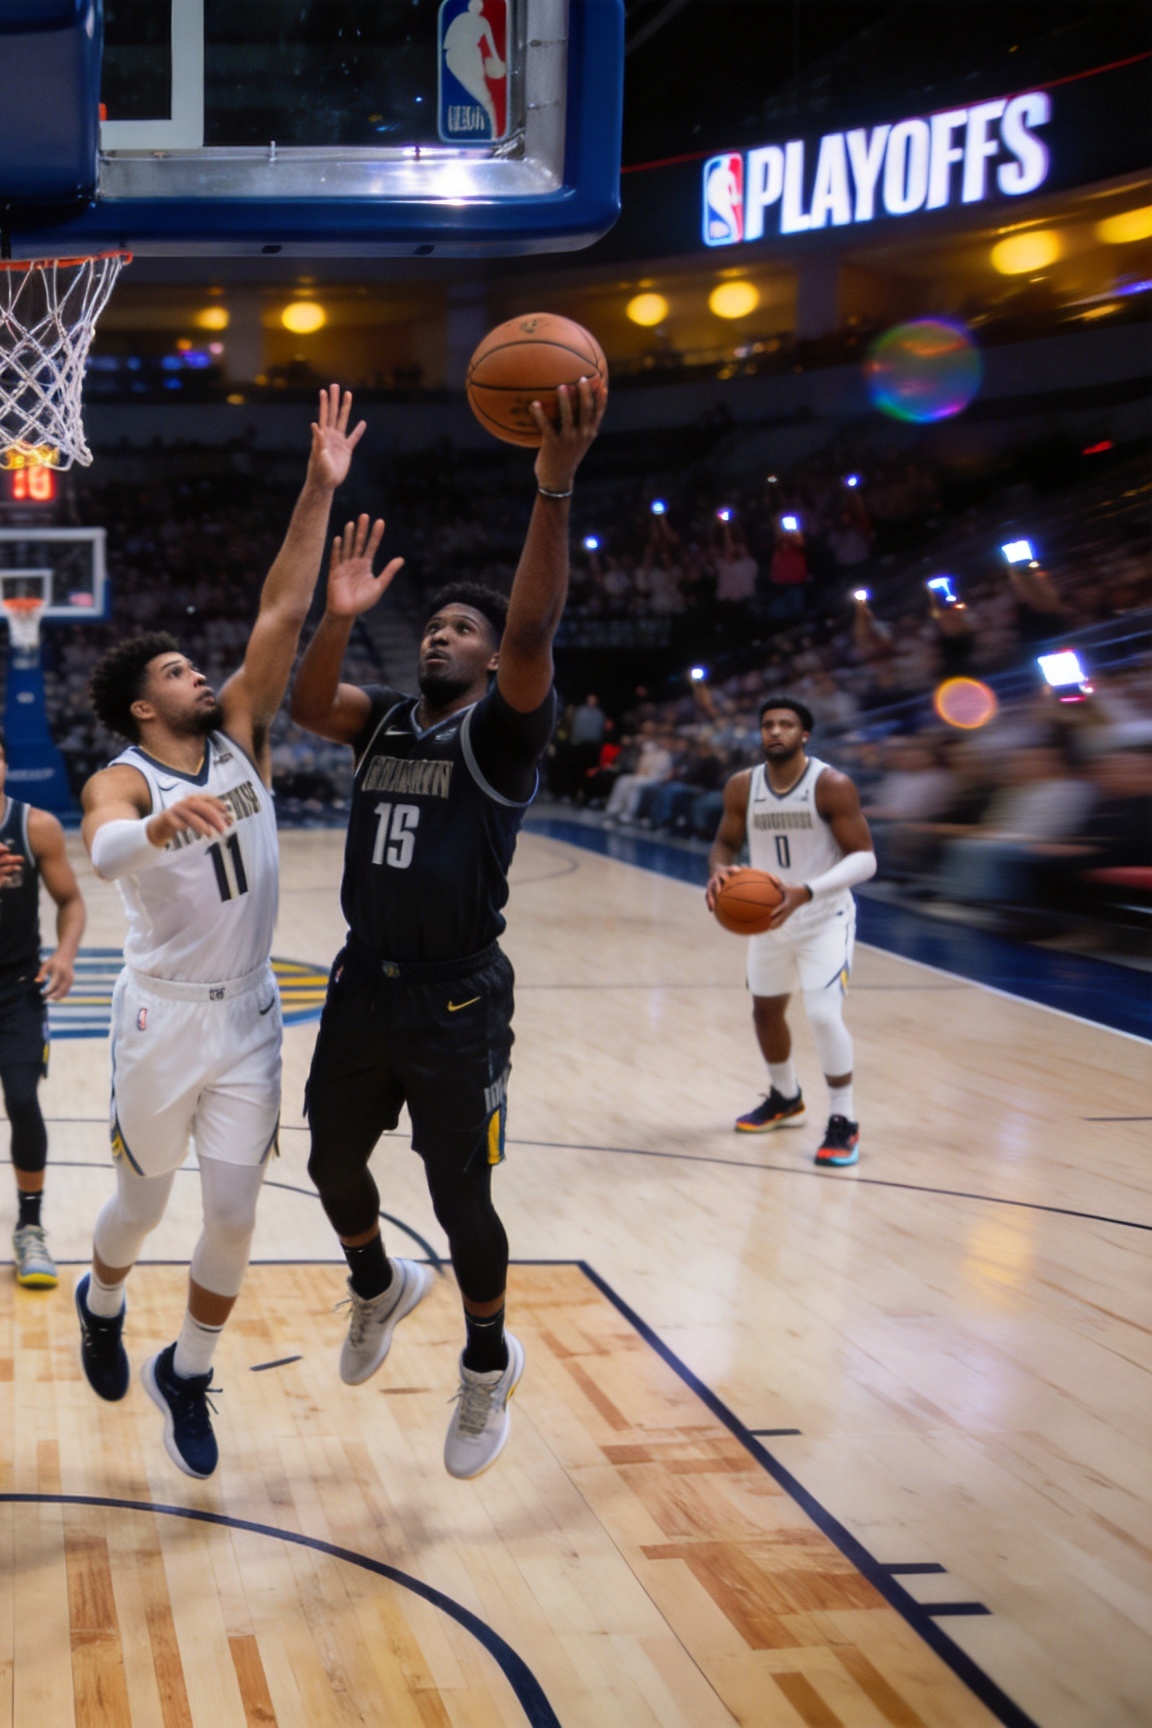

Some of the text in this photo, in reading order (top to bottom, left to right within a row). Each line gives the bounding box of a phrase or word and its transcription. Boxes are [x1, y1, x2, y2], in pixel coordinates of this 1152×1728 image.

[744, 91, 1051, 241] PLAYOFFS
[205, 831, 249, 903] 11
[372, 802, 420, 869] 15
[774, 834, 791, 869] 0
